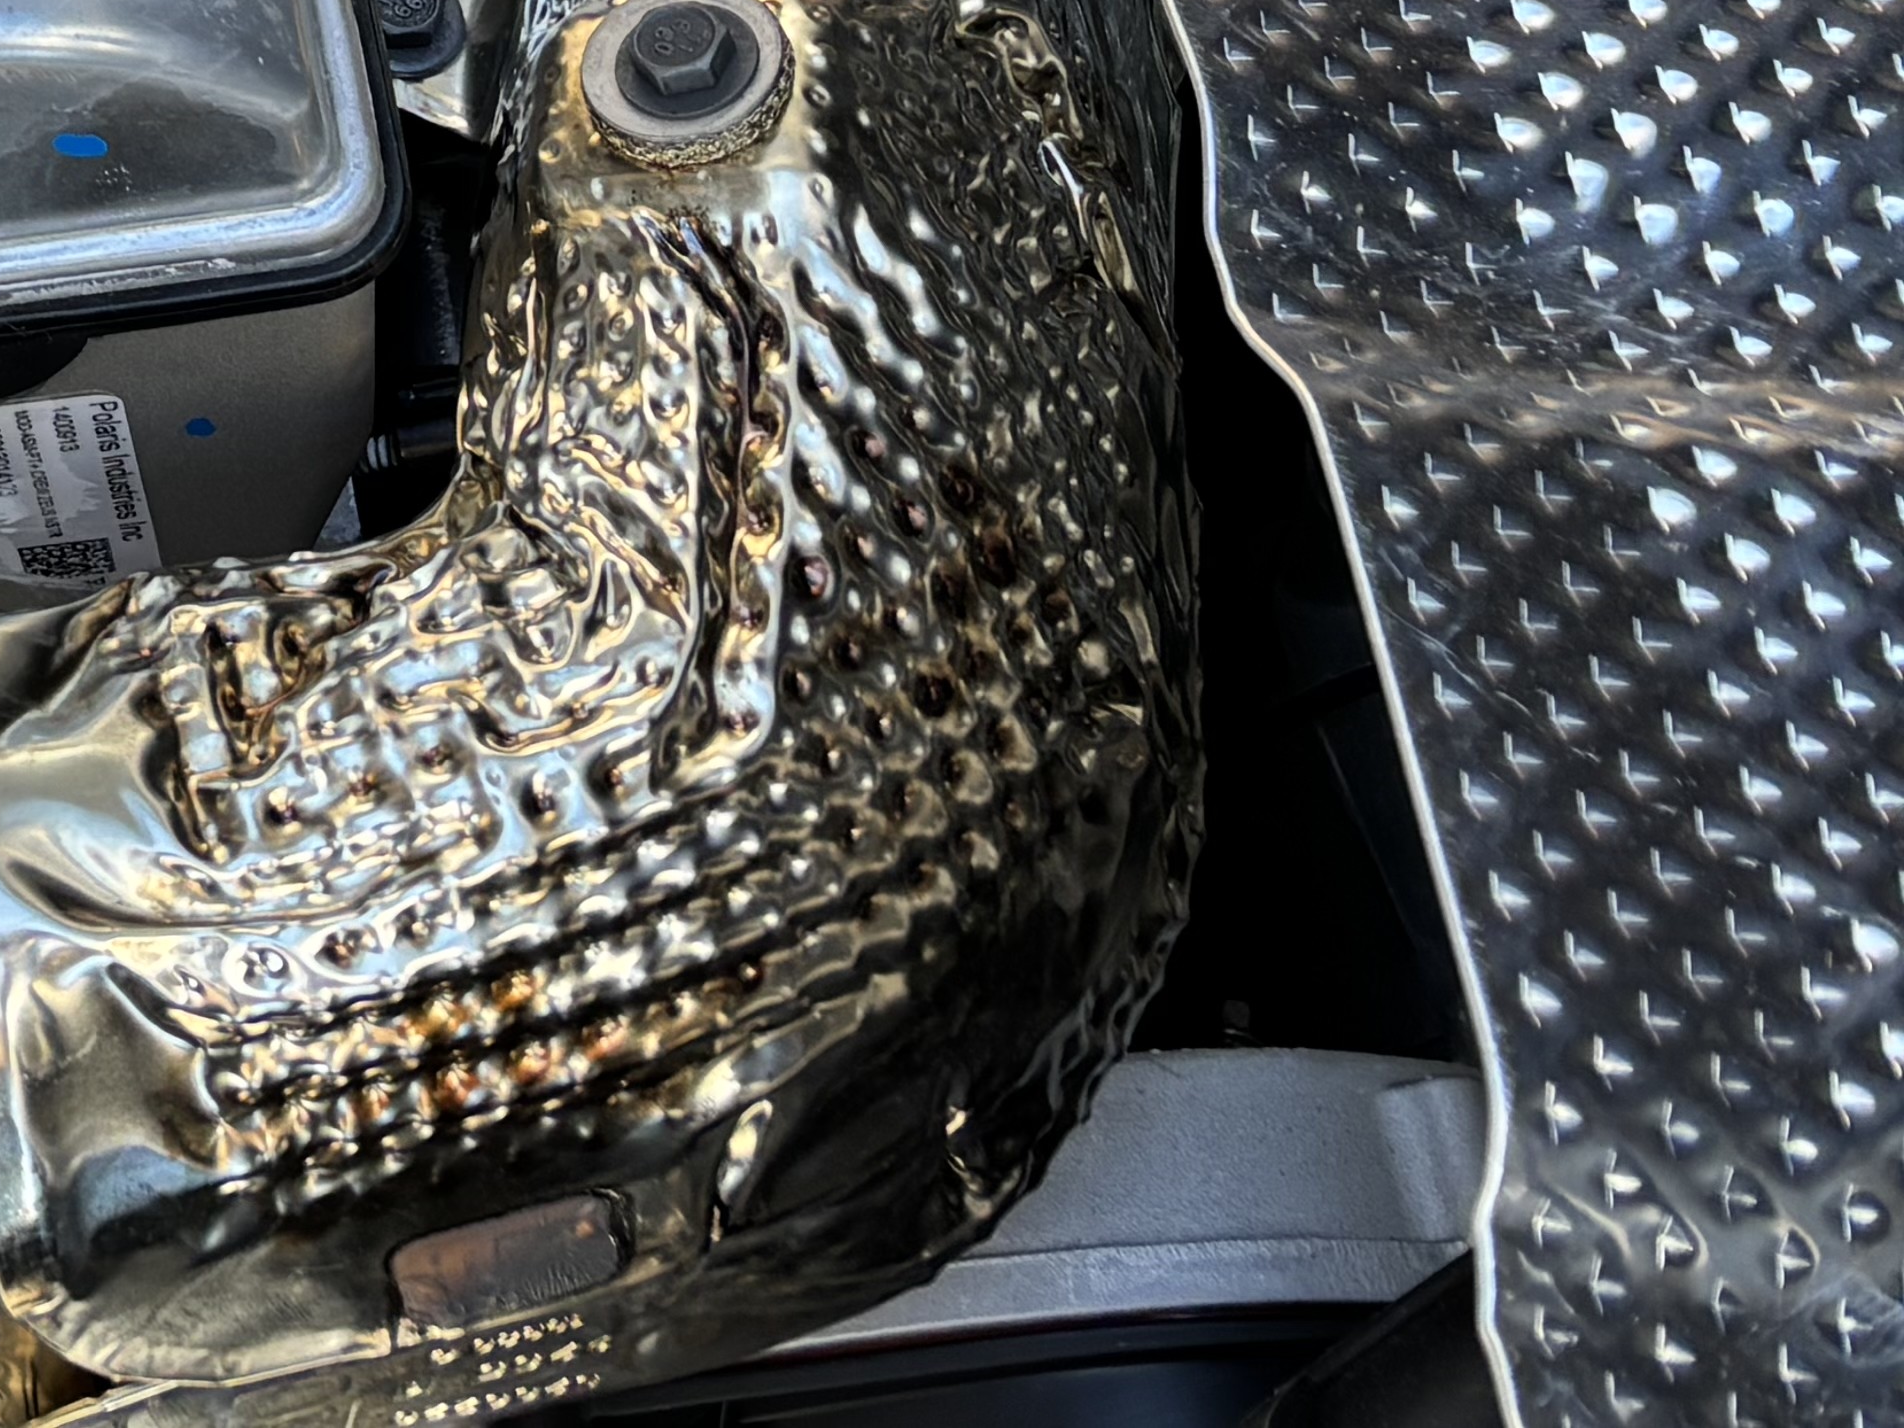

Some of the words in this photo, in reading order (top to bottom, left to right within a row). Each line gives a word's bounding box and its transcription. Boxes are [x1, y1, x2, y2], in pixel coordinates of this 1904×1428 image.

[89, 401, 127, 453] Polaris
[102, 453, 141, 521] Industries
[119, 521, 149, 543] Inc
